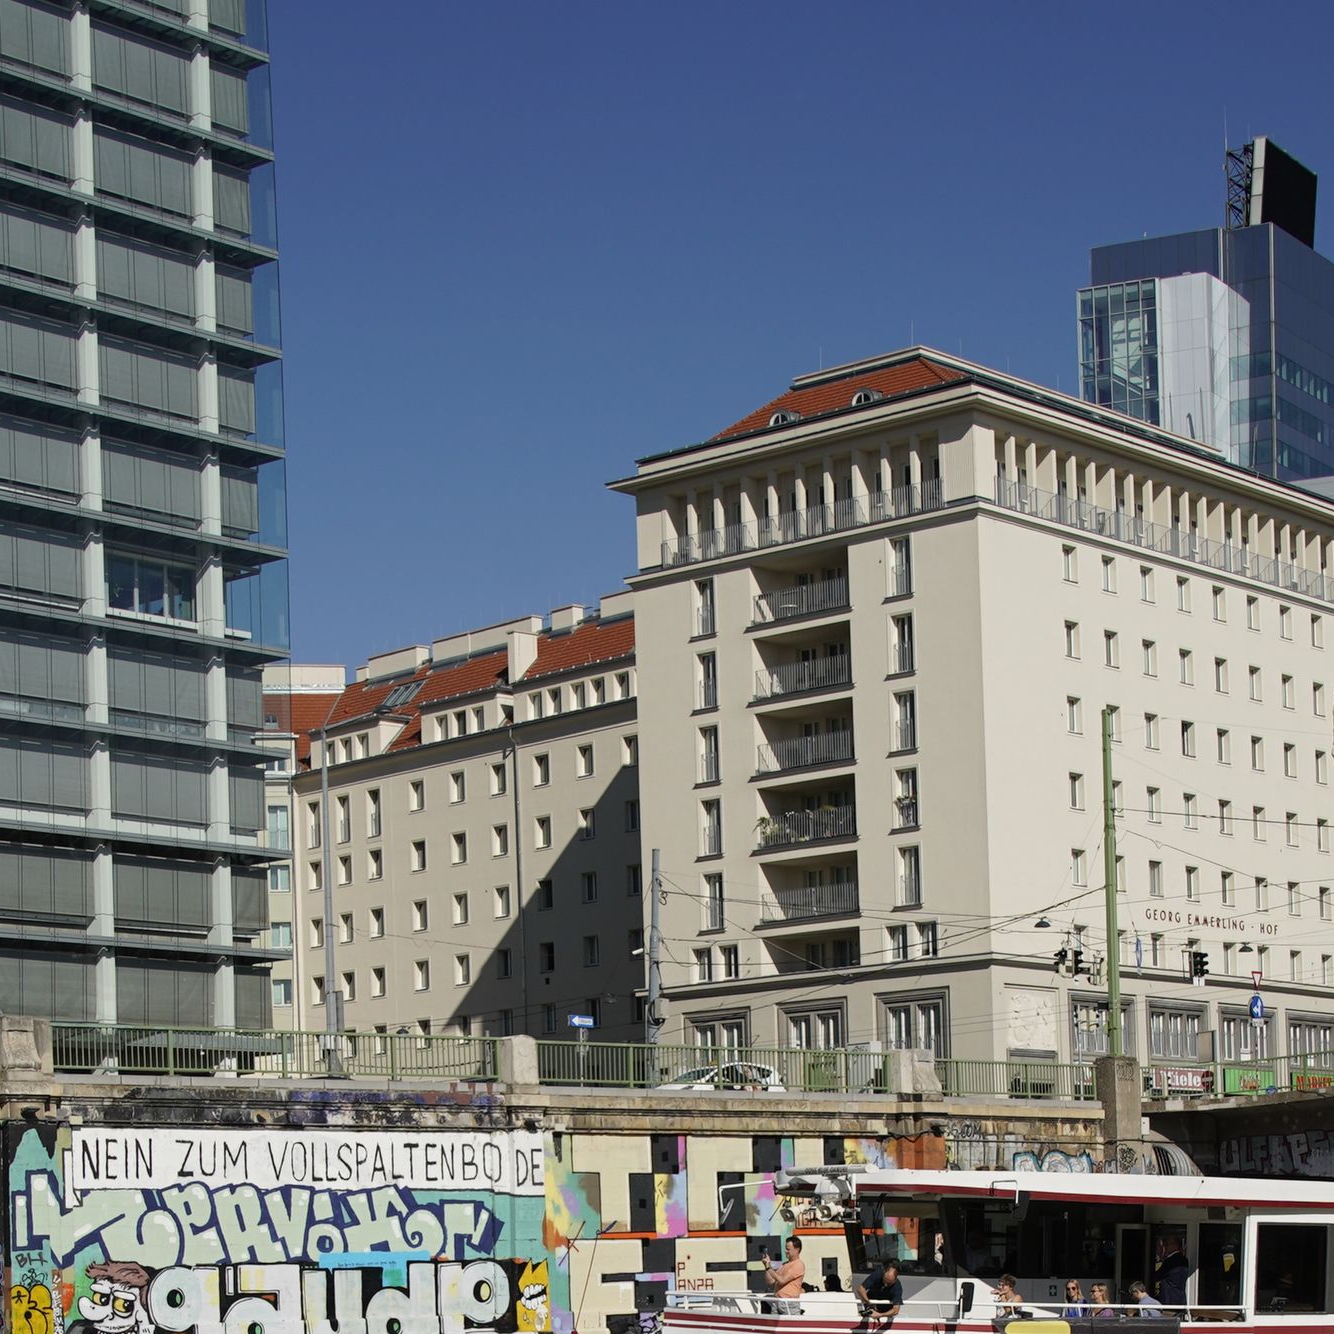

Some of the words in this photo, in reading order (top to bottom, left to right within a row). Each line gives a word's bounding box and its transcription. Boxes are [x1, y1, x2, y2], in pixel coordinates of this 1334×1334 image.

[1145, 908, 1181, 923] GEORG
[1187, 913, 1245, 931] EMMERLING
[1259, 923, 1279, 935] HOF
[80, 1138, 154, 1180] NEIN
[176, 1139, 248, 1179] ZUM
